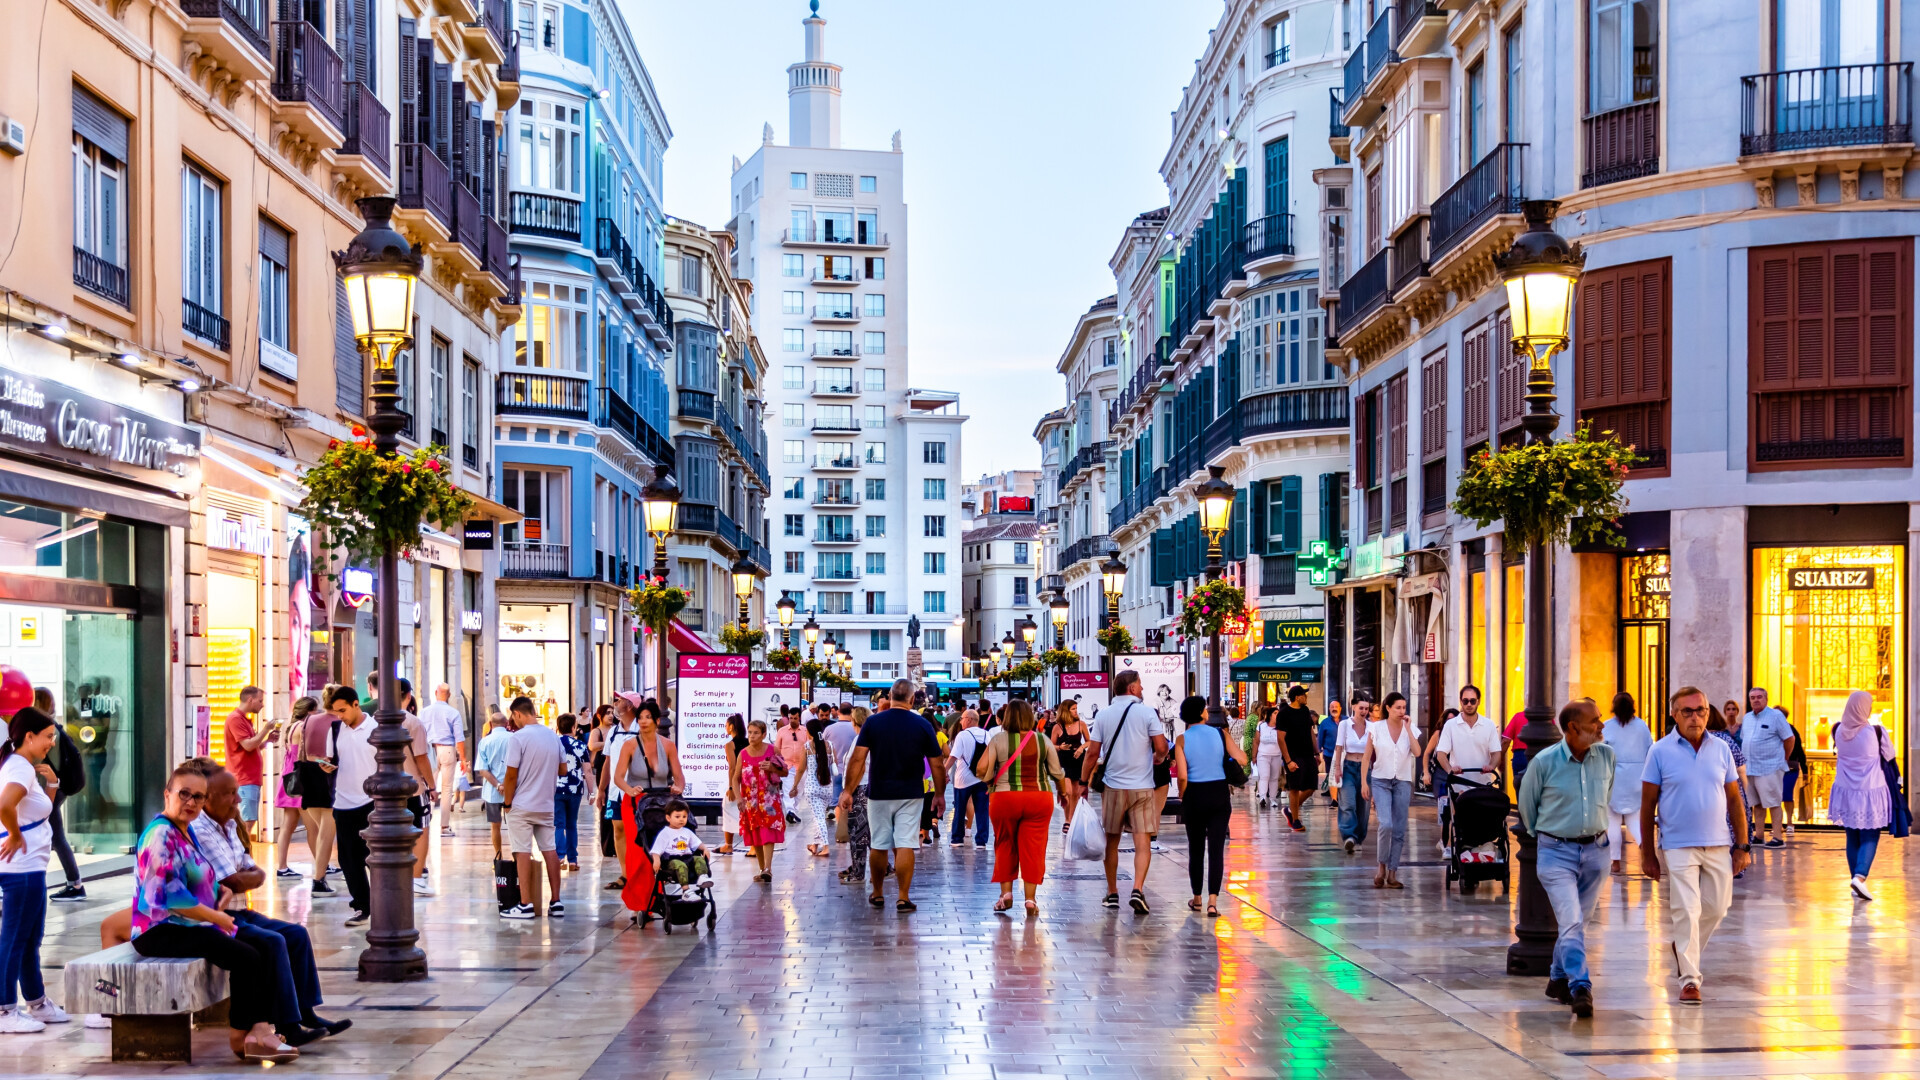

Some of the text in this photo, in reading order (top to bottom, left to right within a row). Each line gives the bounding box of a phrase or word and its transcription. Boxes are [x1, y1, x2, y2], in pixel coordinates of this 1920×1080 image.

[58, 398, 113, 456] Casa
[1794, 570, 1868, 587] SUAREZ
[462, 611, 482, 630] MANGO
[707, 690, 728, 698] mujer
[730, 691, 735, 699] y
